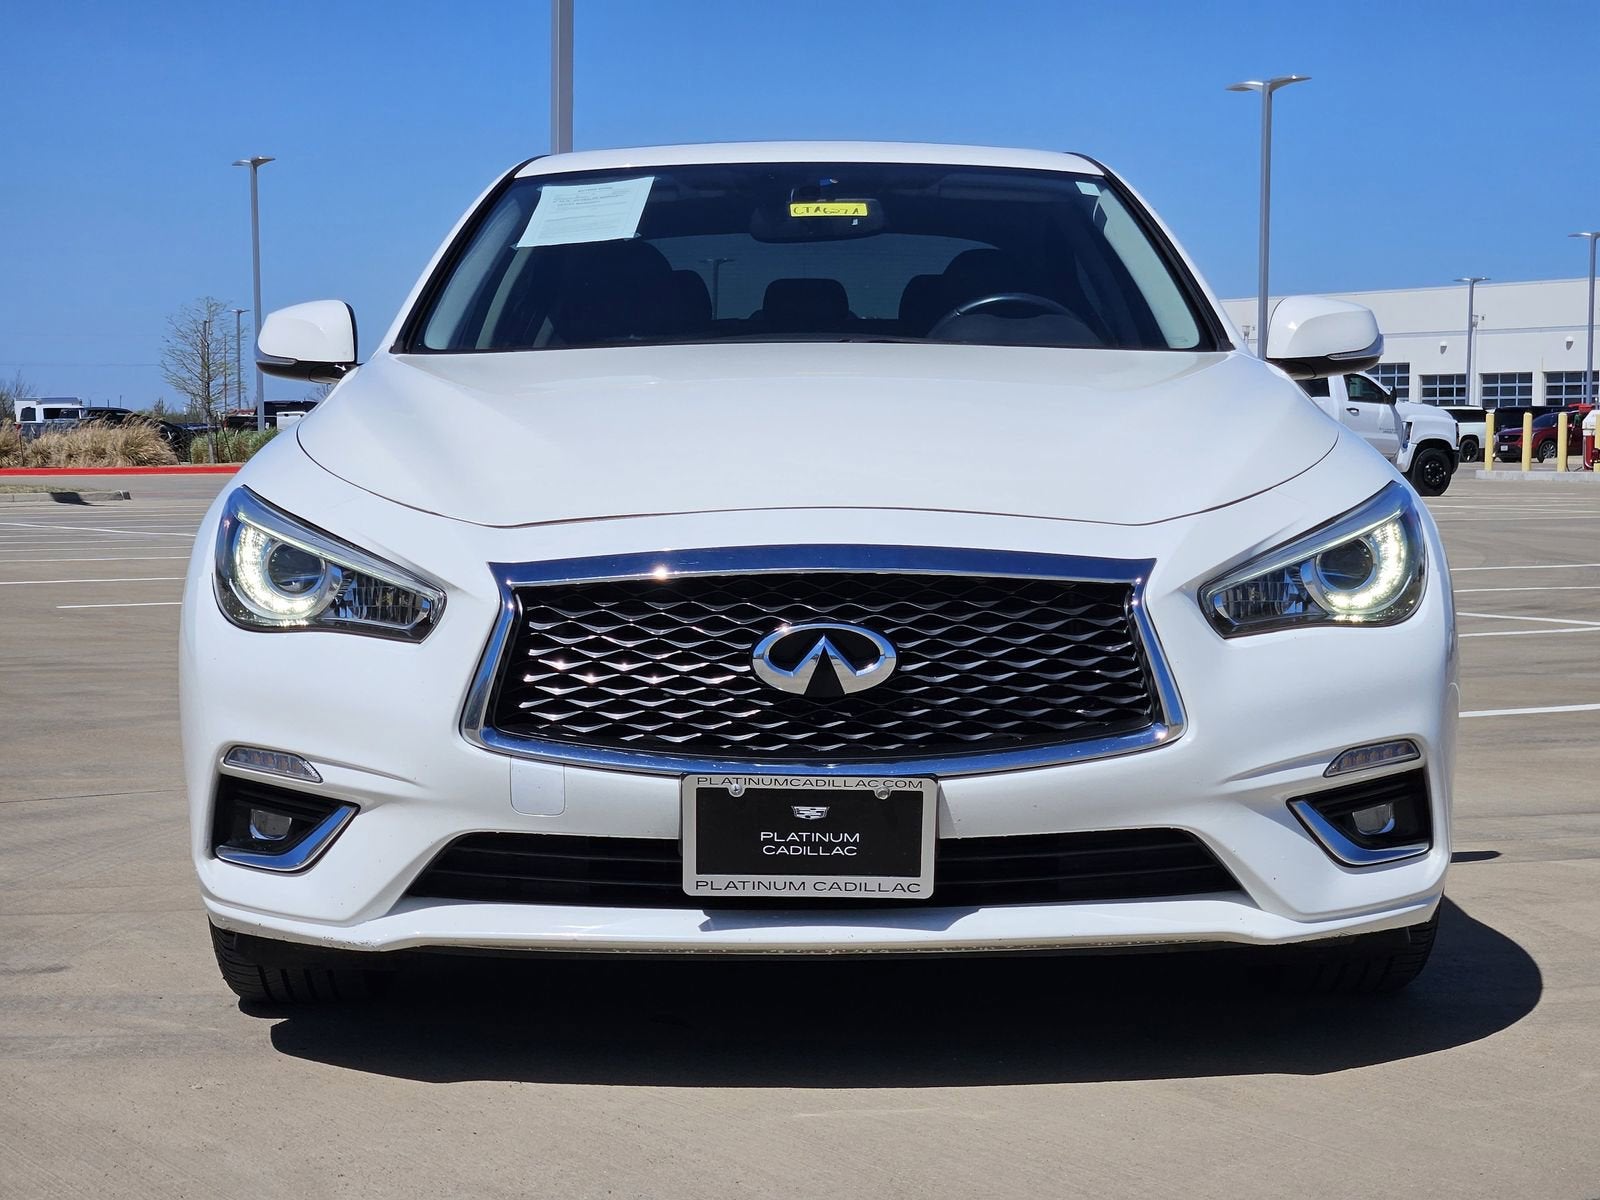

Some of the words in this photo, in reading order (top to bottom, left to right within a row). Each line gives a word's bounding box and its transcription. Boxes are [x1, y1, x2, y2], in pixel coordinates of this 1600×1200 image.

[697, 777, 923, 789] PLATINUMCADILLACCOM
[760, 832, 860, 843] PLATINUM
[762, 845, 858, 857] CADILLAC
[696, 880, 806, 891] PLATINUM
[813, 881, 921, 893] CADILLAC
